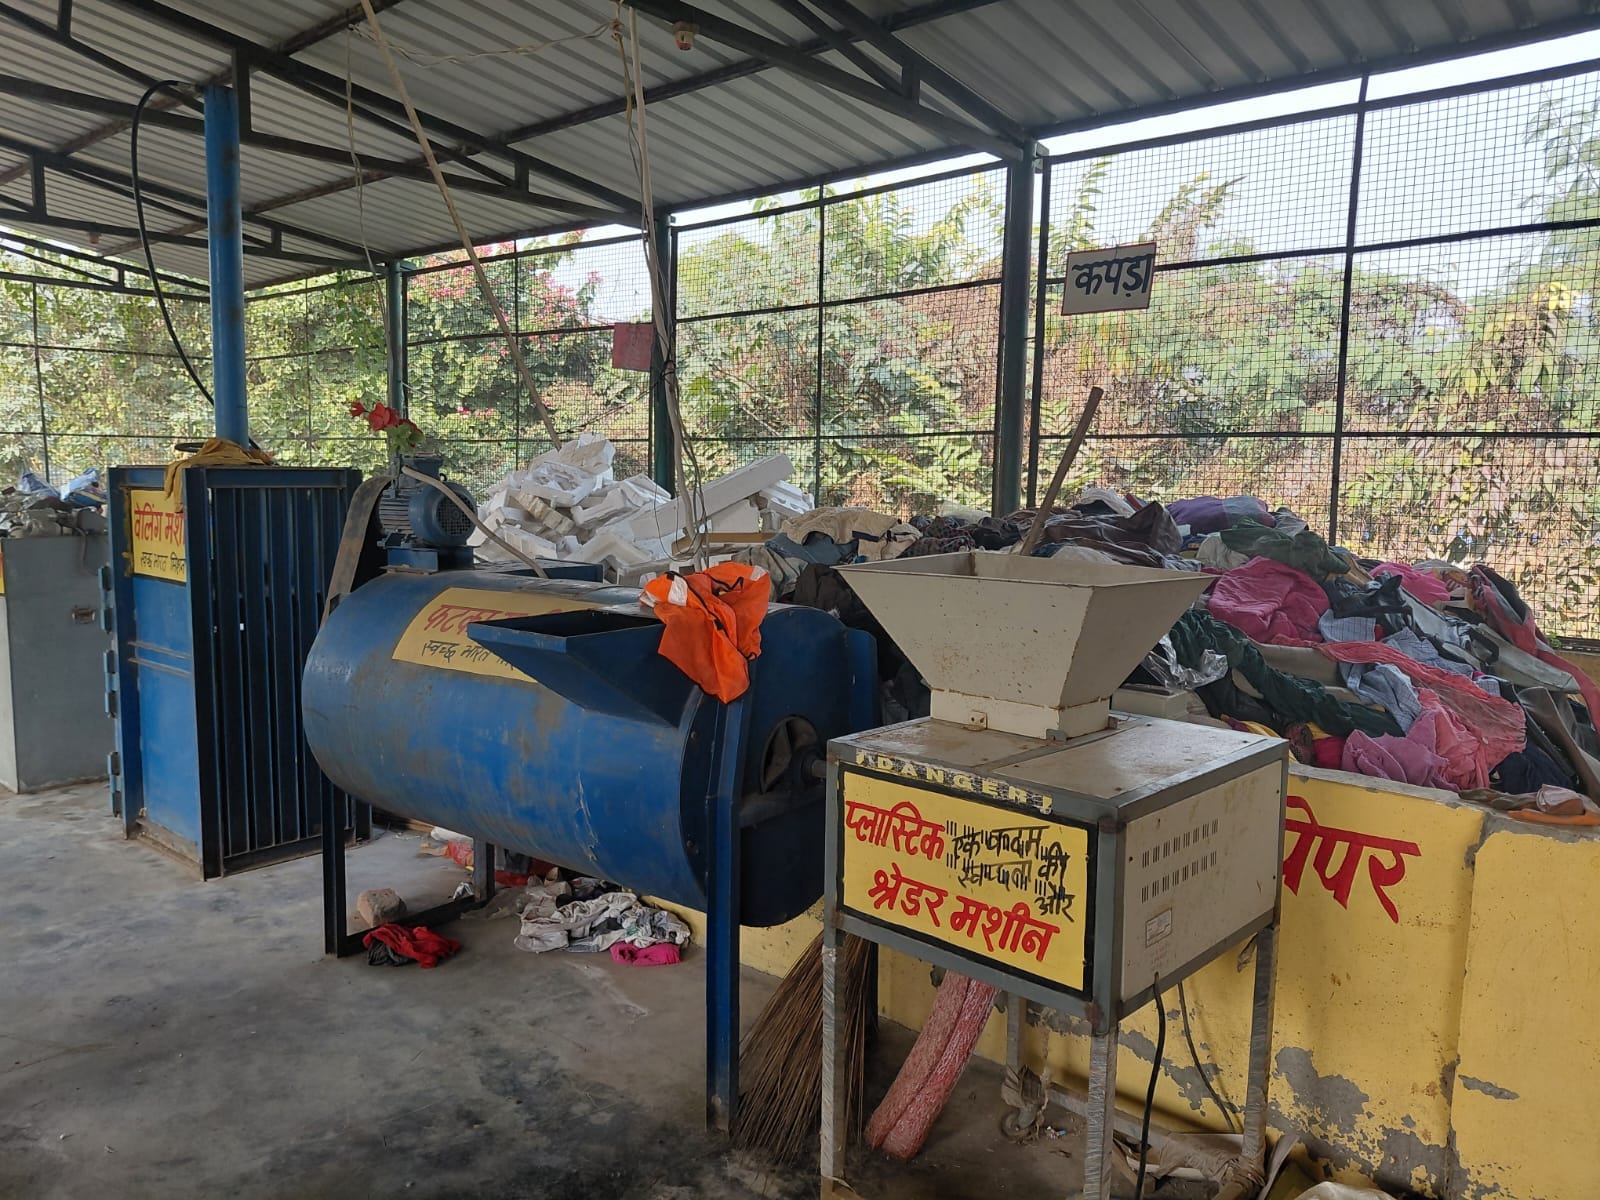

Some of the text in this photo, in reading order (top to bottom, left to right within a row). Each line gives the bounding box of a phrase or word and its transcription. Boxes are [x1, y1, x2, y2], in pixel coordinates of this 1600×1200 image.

[1072, 254, 1155, 297] कपड़ा
[877, 754, 1028, 803] DANGER
[845, 801, 945, 861] प्लास्टिक
[952, 832, 981, 859] एक
[868, 862, 1060, 961] श्रेडर मशीन
